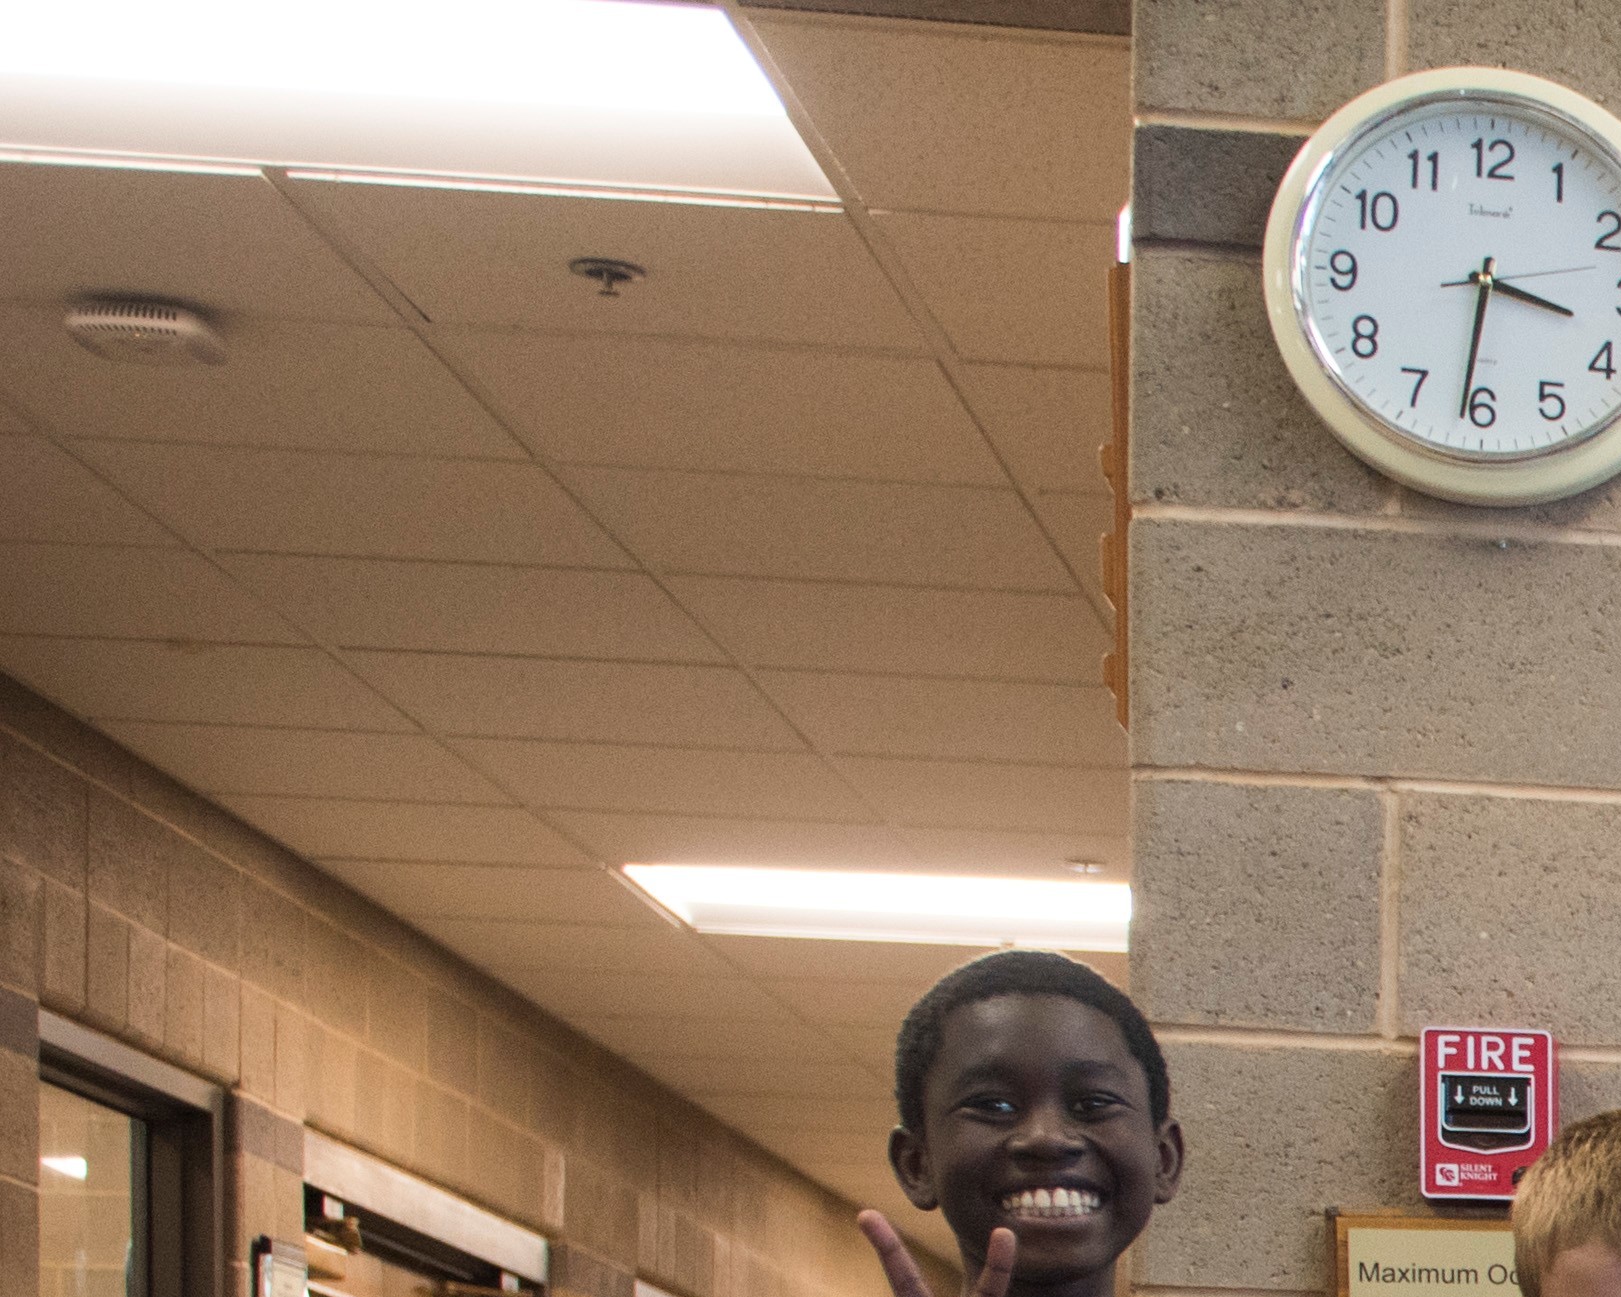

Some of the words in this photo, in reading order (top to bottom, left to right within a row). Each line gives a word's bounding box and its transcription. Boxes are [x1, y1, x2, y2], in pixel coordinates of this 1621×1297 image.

[1408, 149, 1439, 191] 11
[1471, 137, 1515, 180] 12
[1551, 162, 1565, 203] 1
[1356, 188, 1399, 232] 10
[1330, 249, 1357, 291] 9
[1351, 314, 1379, 359] 8
[1588, 340, 1616, 380] 4
[1401, 367, 1429, 408] 7
[1468, 386, 1497, 428] 6
[1538, 381, 1566, 421] 5
[1437, 1035, 1535, 1072] FIRE
[1469, 1096, 1502, 1107] DOWN
[1472, 1085, 1500, 1096] PULL
[1460, 1164, 1493, 1174] SILENT
[1460, 1171, 1498, 1182] KNIGHT
[1359, 1262, 1479, 1285] Maximum
